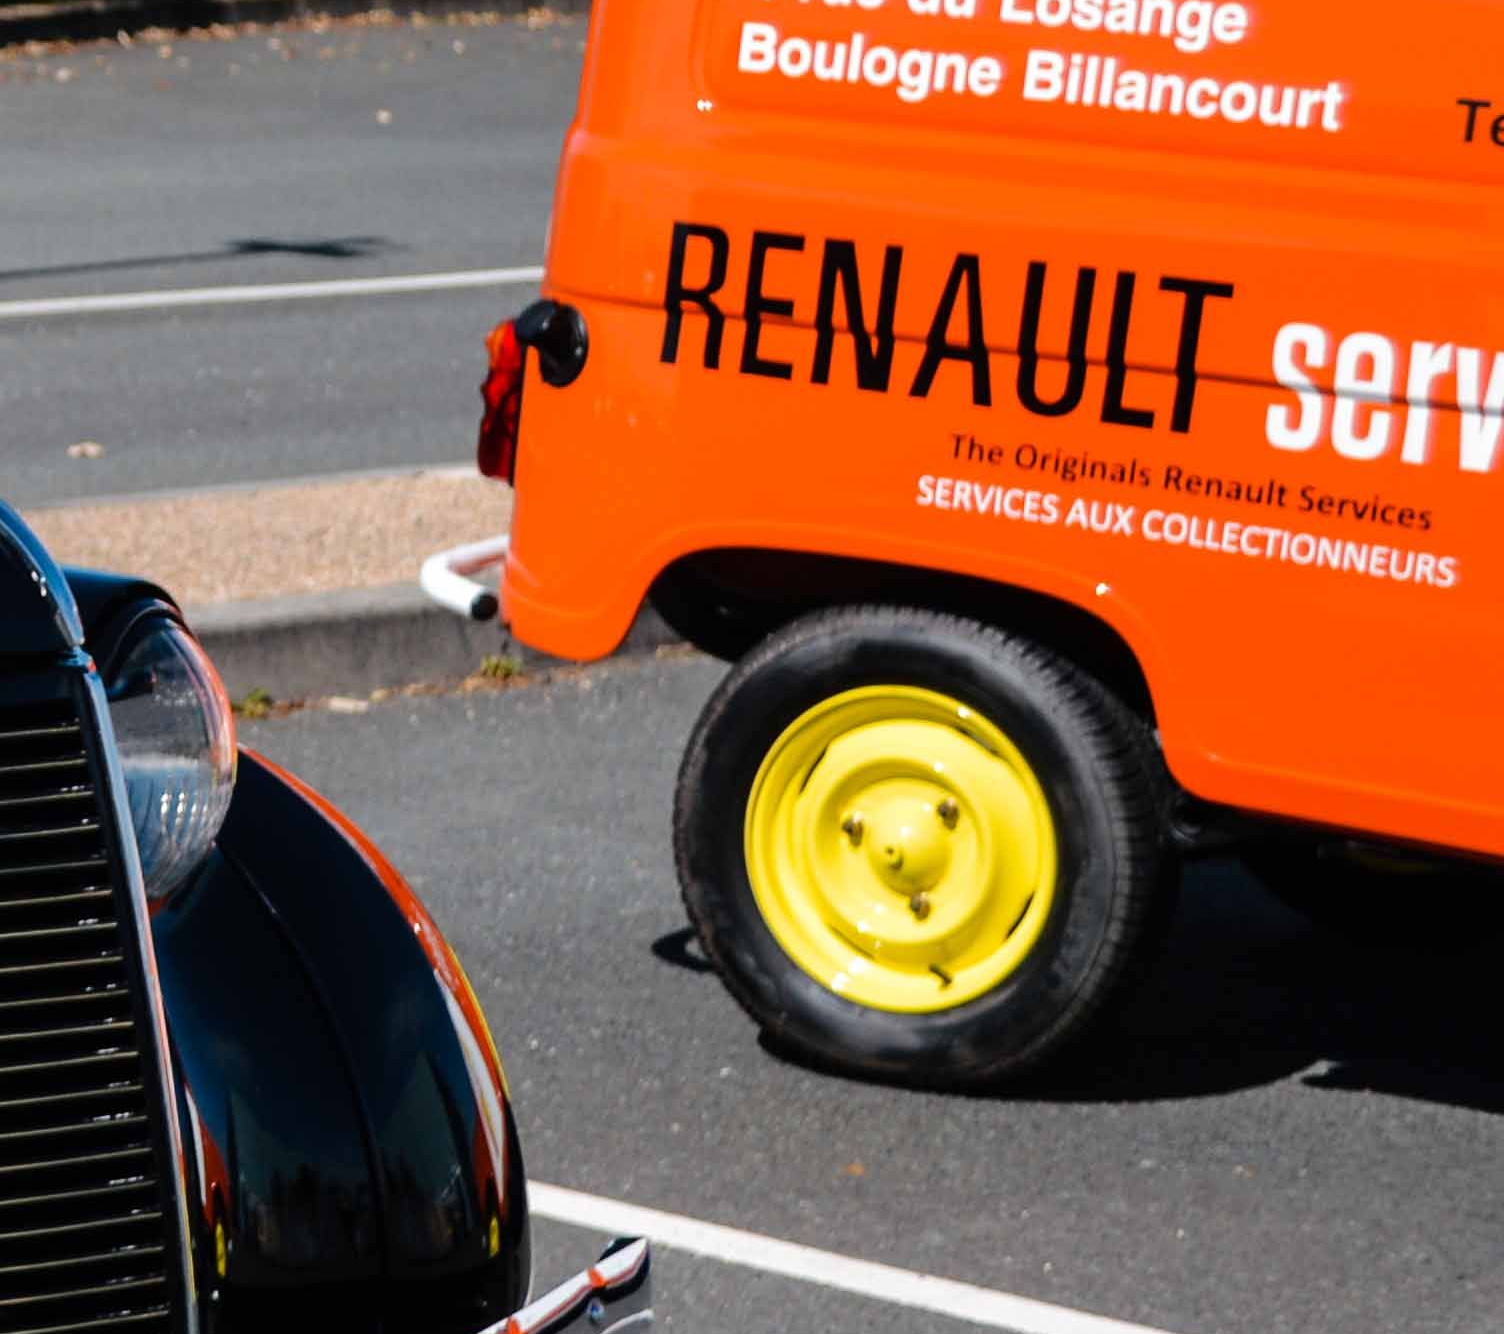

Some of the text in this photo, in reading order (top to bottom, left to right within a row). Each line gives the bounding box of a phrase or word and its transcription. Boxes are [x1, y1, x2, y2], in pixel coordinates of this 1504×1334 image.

[737, 22, 1345, 132] Boulogne Billancourt
[659, 221, 1235, 434] RENAULT
[916, 474, 1457, 589] SERVICES AUX COLLECTIONNEURS
[950, 434, 1434, 532] The Originals Renault Services
